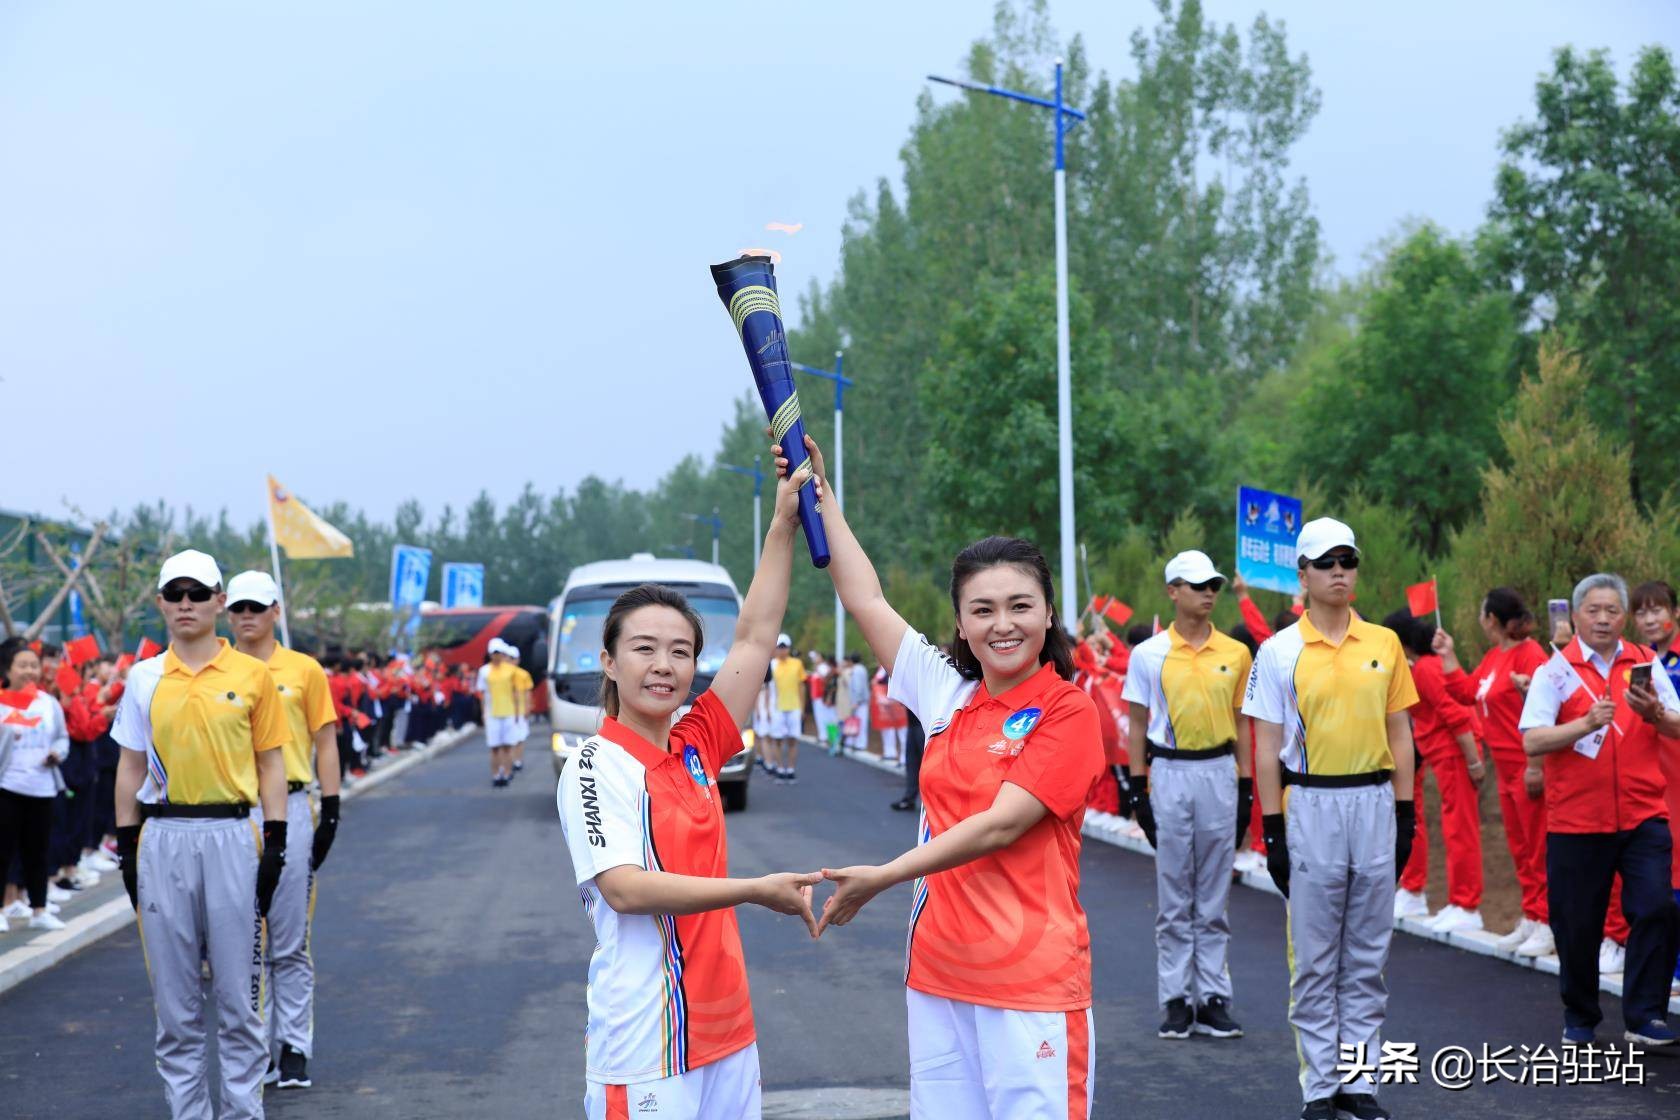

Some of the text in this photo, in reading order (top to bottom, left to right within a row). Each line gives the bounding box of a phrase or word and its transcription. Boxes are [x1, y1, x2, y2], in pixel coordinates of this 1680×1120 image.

[1010, 713, 1036, 731] 41
[690, 755, 703, 776] 42
[580, 777, 606, 847] SHANXI
[251, 973, 260, 1012] 2019
